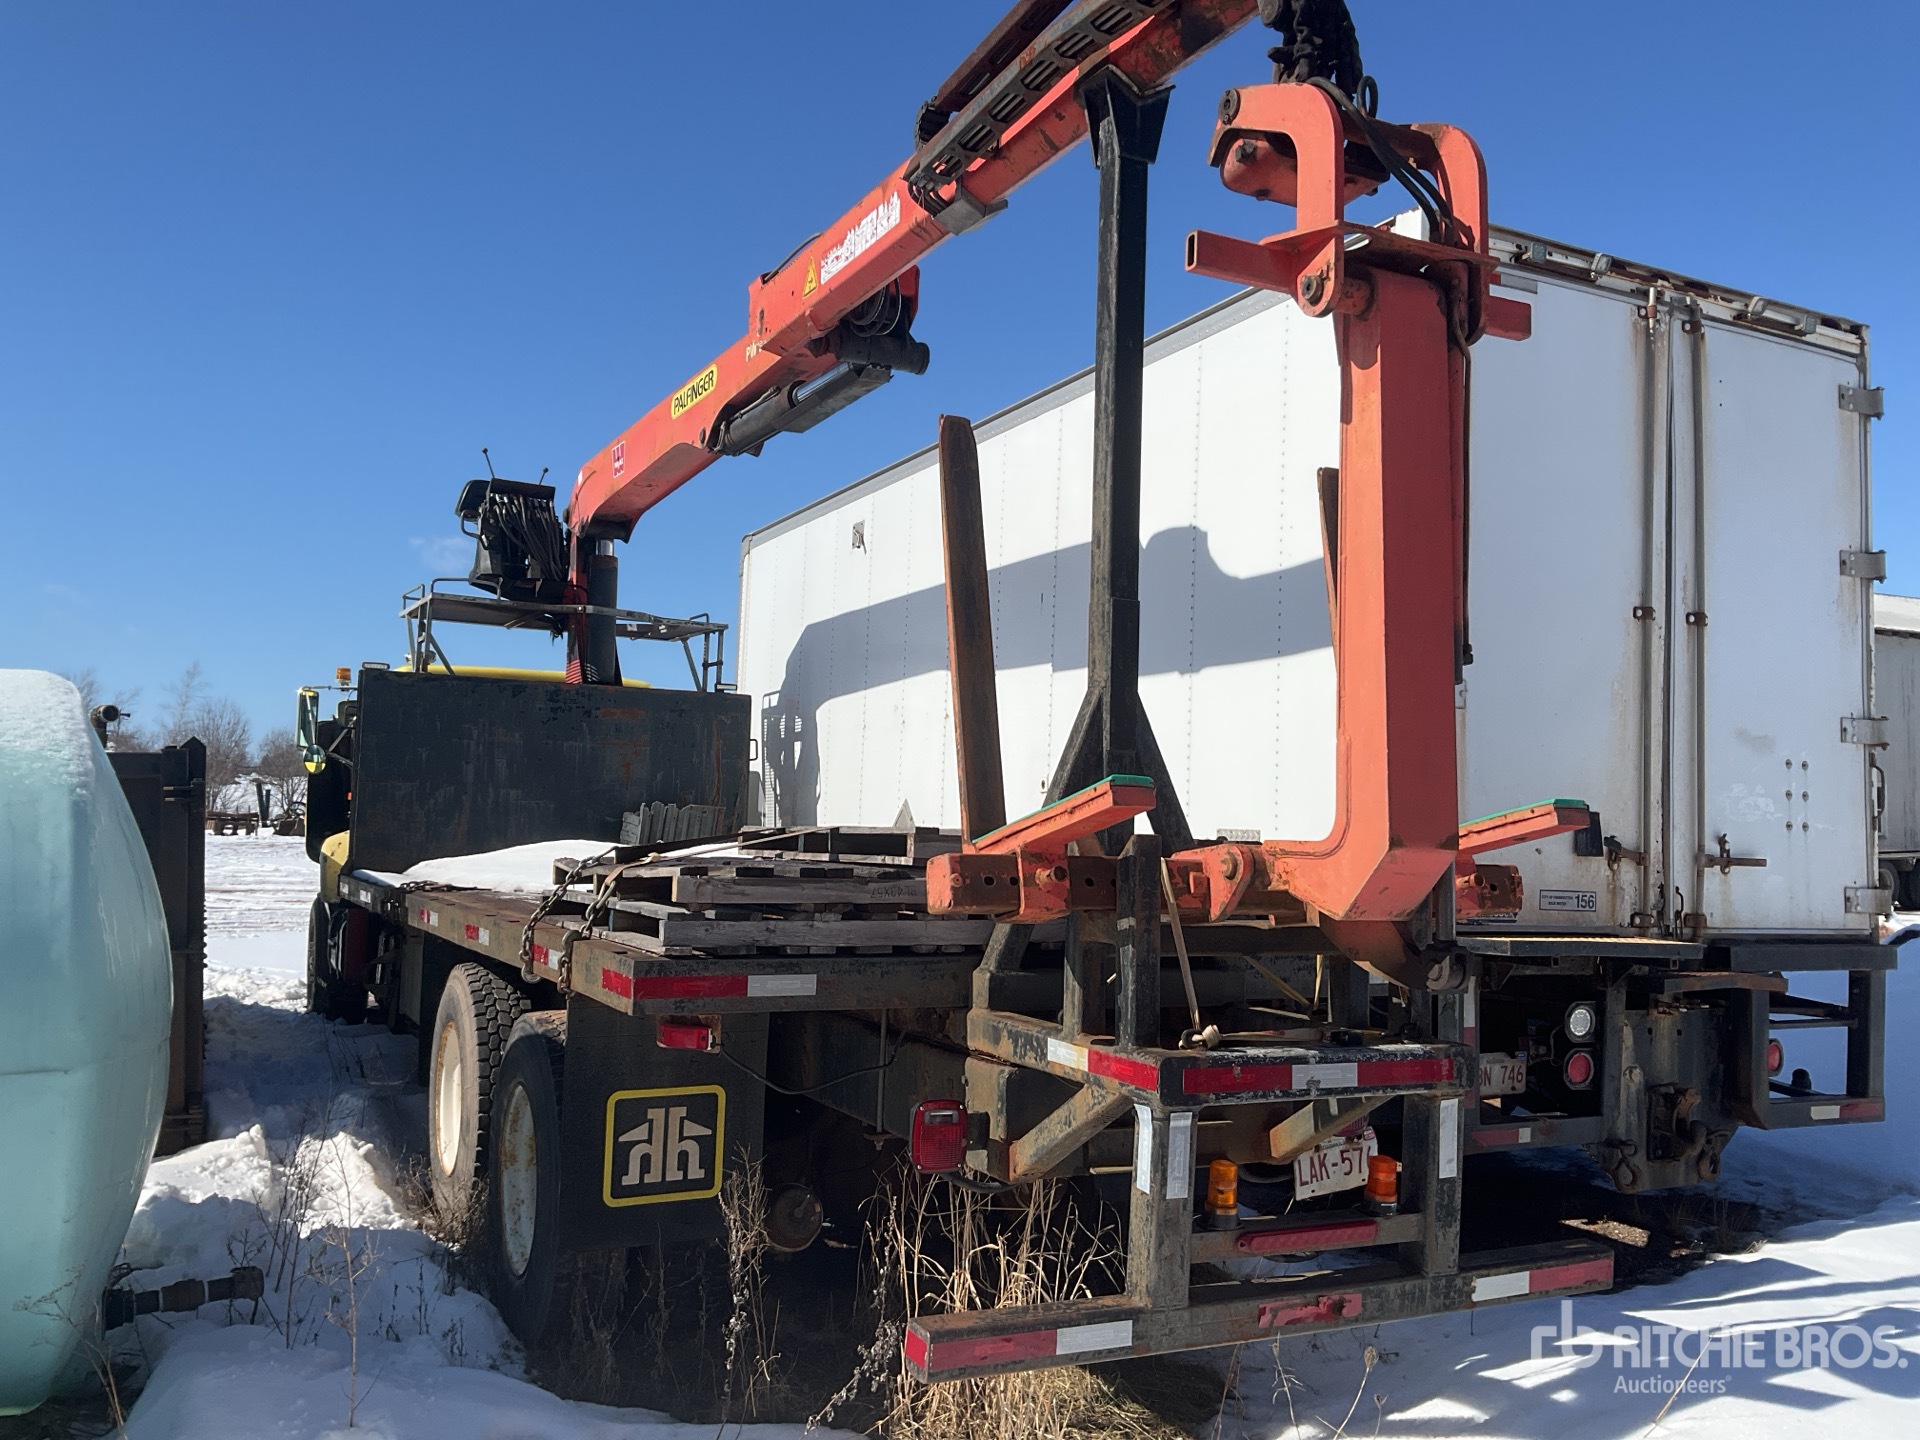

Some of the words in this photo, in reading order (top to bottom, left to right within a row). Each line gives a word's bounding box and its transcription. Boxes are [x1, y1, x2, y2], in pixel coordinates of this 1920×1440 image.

[673, 369, 714, 415] PALFINGER
[1574, 893, 1595, 909] 156
[1500, 1064, 1524, 1085] 746
